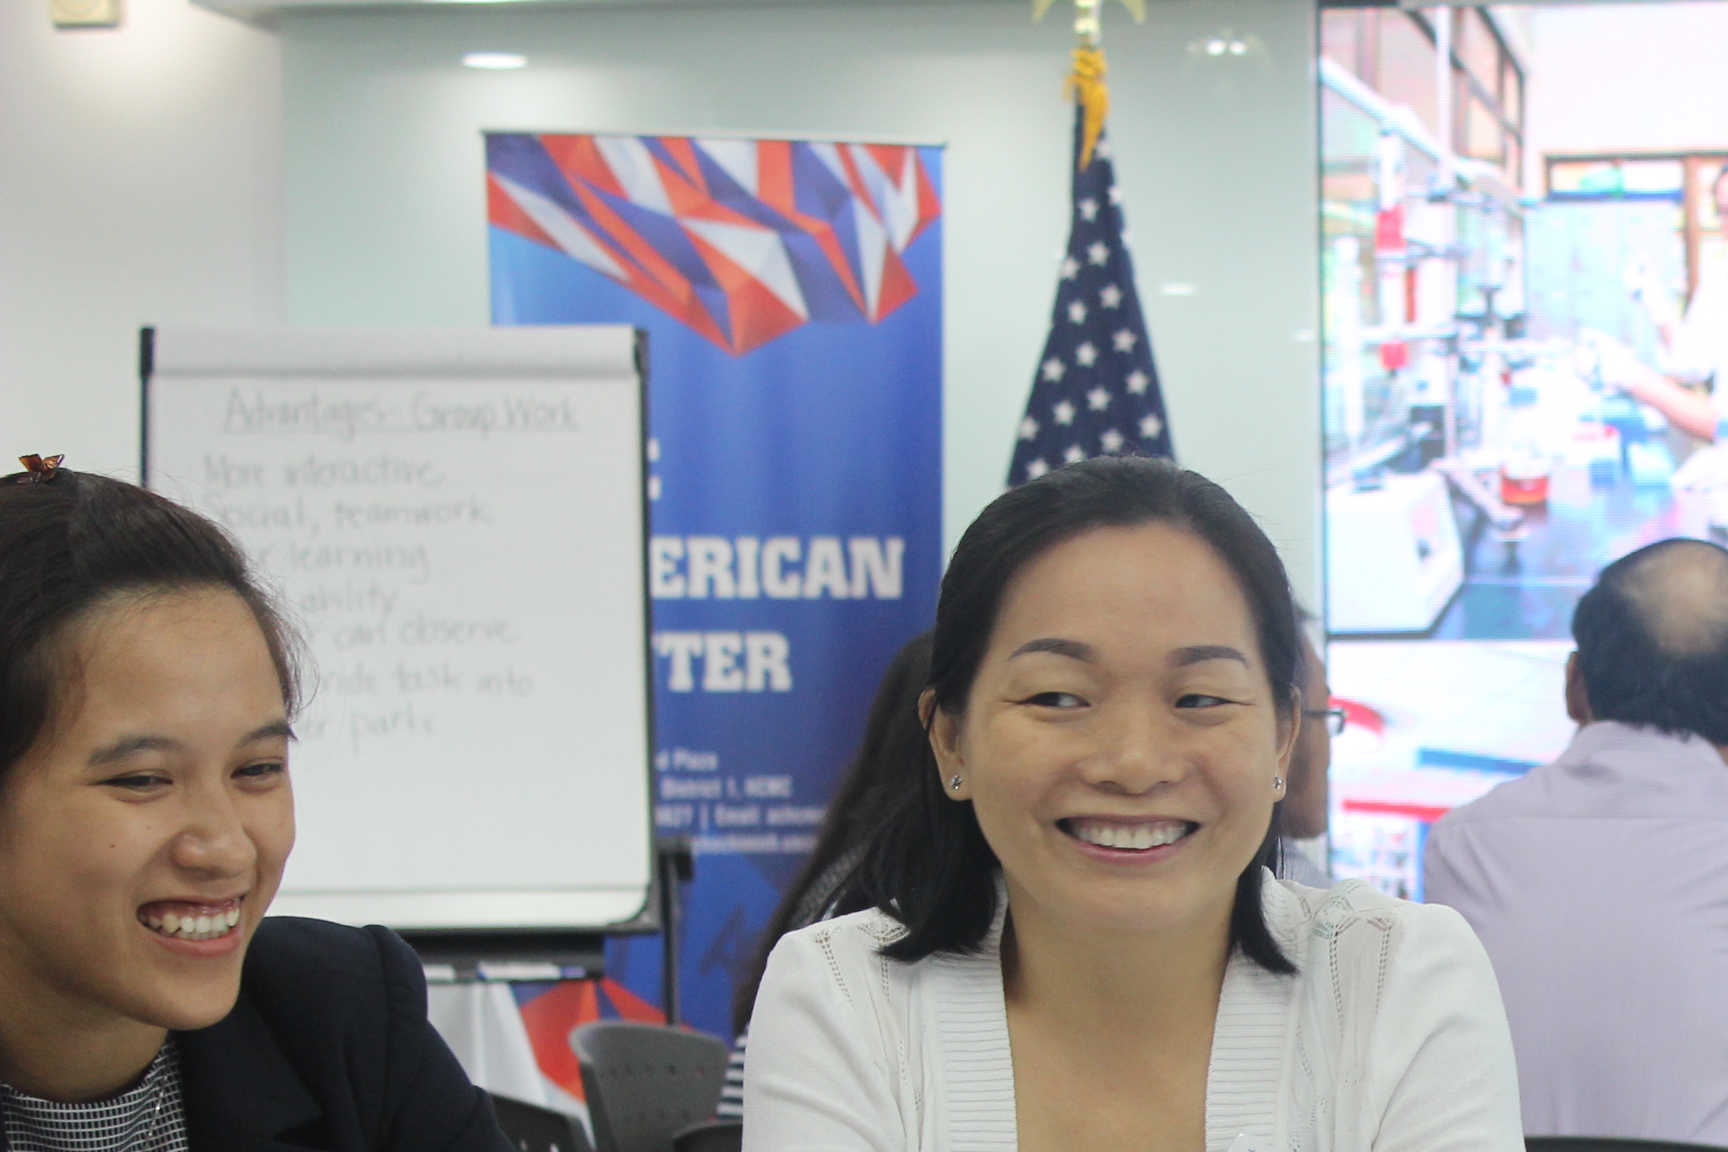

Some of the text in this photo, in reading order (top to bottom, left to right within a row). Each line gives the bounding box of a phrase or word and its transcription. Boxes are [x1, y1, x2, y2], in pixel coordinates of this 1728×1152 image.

[411, 391, 498, 439] Group
[502, 394, 579, 431] Work
[648, 536, 905, 600] ERICAN
